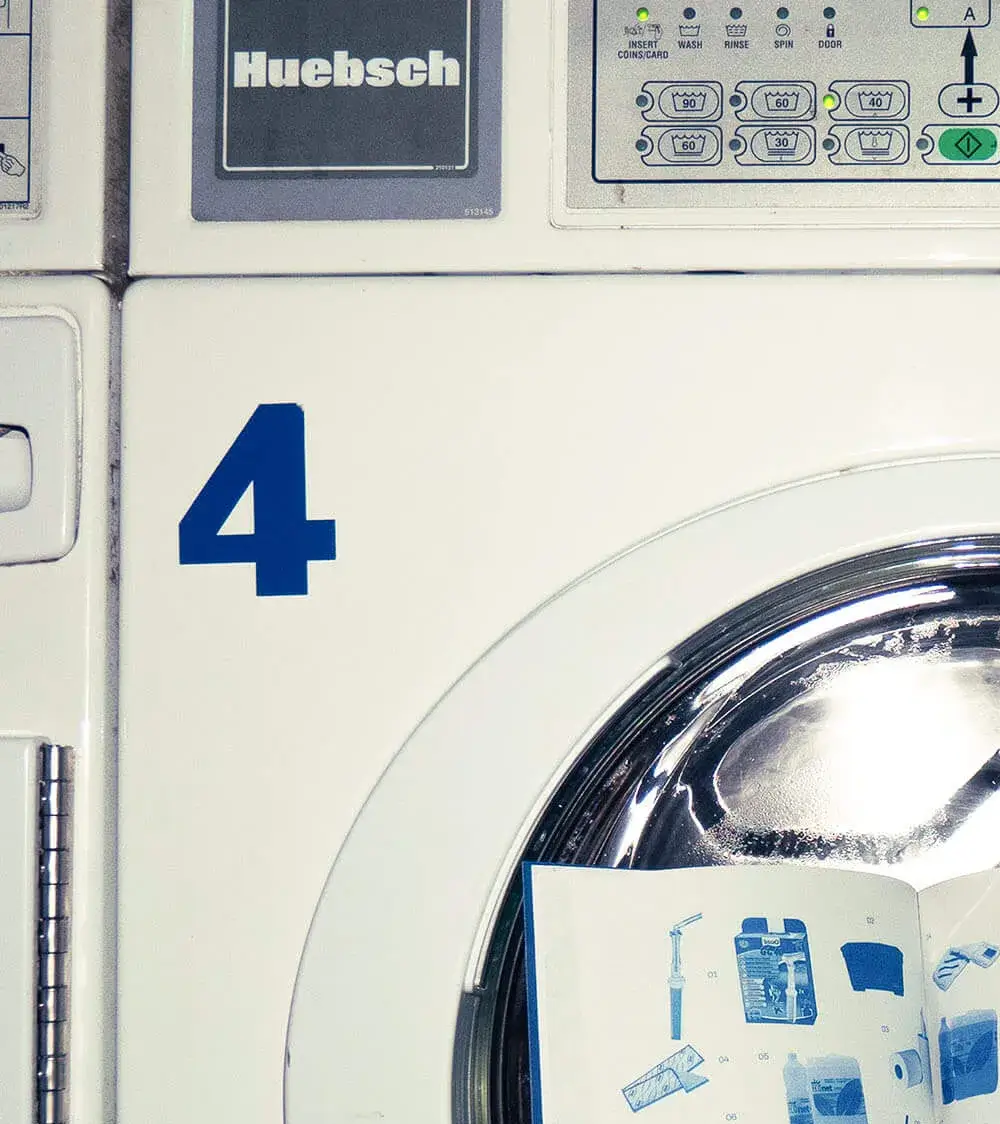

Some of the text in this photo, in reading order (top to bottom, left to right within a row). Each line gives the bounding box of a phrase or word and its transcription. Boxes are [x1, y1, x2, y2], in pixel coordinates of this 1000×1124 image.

[963, 6, 976, 21] A
[628, 40, 658, 49] INSERT
[678, 40, 703, 49] WASH
[724, 40, 750, 49] RINSE
[774, 40, 794, 49] SPIN
[818, 40, 842, 49] DOOR
[617, 50, 669, 59] COINS/CARD
[233, 50, 460, 88] Huebsch
[681, 97, 697, 109] 90
[775, 98, 790, 109] 60
[868, 97, 883, 108] 40
[681, 140, 697, 151] 60
[774, 137, 789, 148] 30
[178, 403, 336, 597] 4
